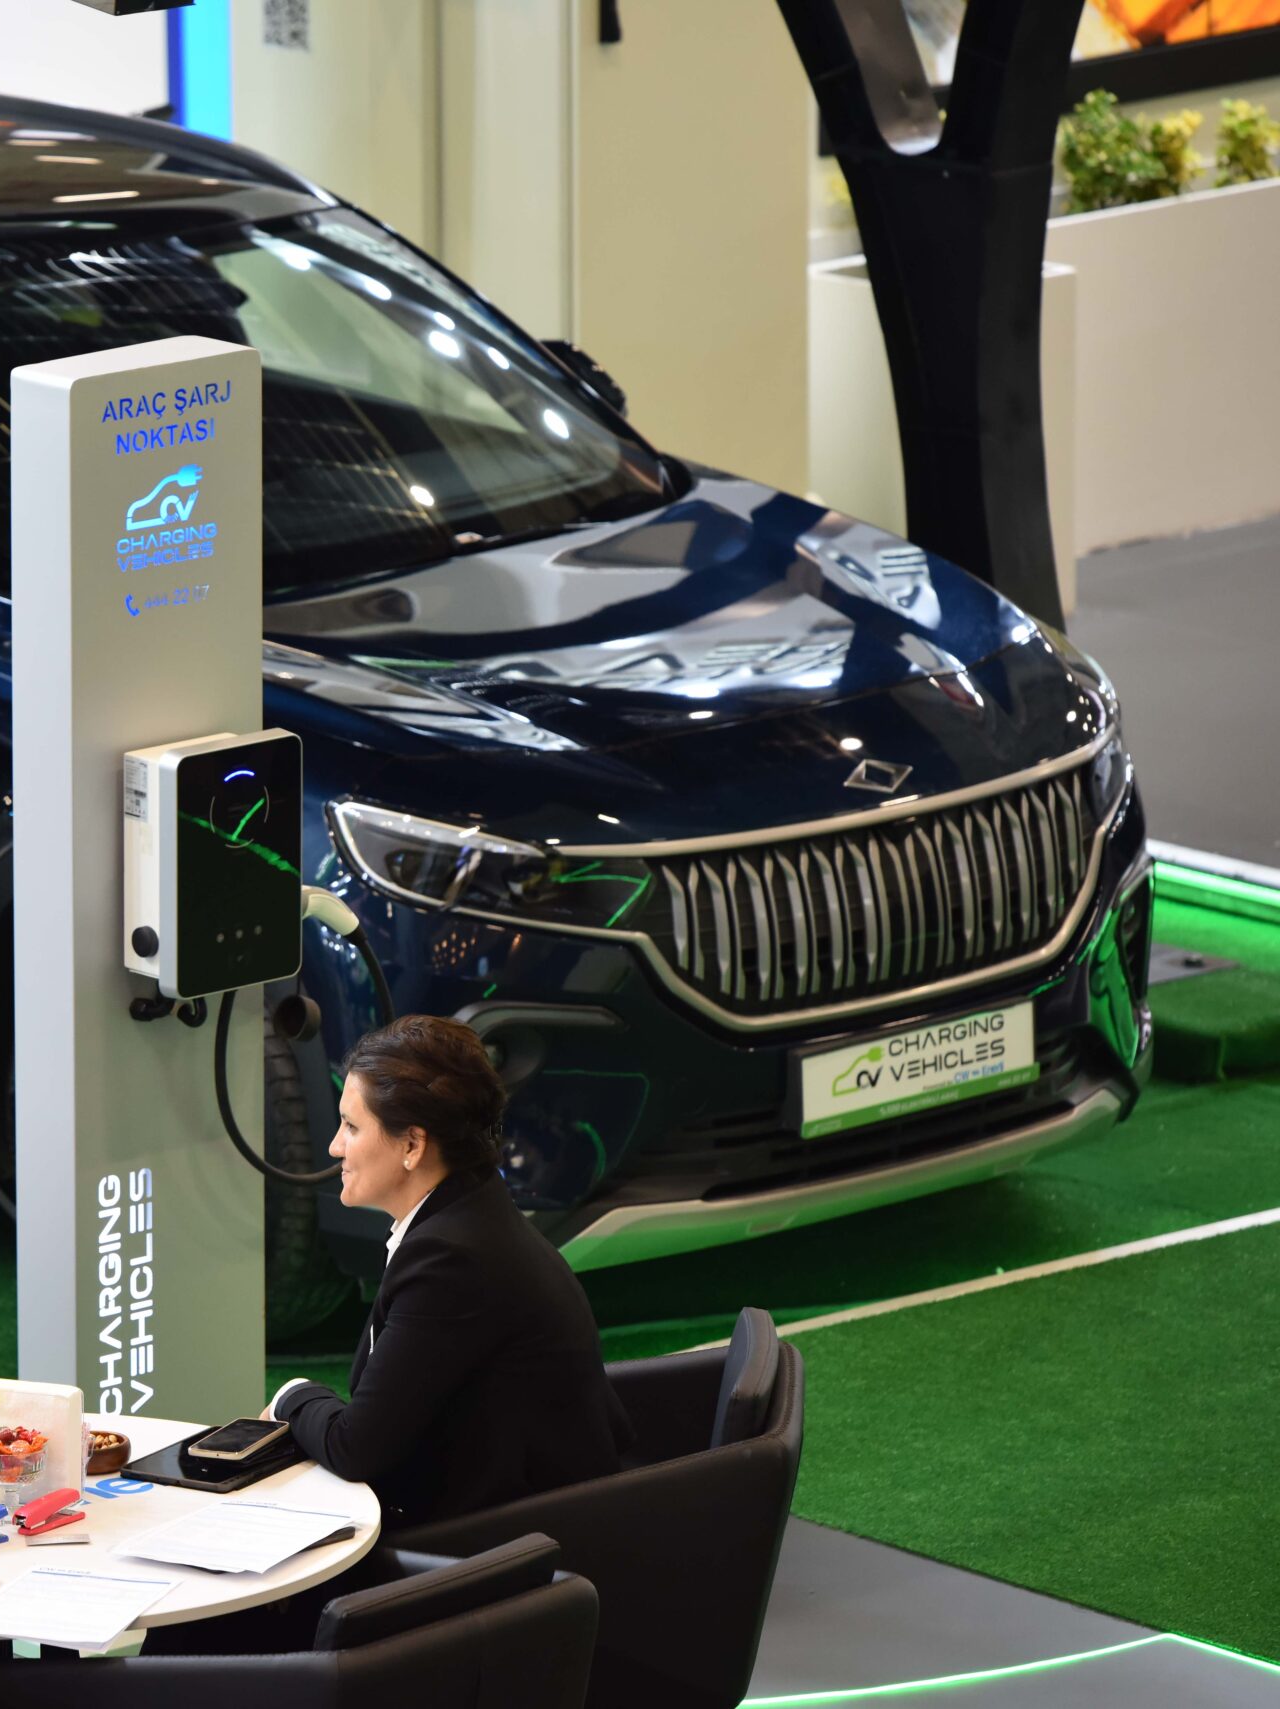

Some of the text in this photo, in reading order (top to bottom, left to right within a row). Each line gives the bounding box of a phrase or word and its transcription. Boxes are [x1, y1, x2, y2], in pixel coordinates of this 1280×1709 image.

[101, 380, 232, 423] ARAÇ ŞARJ
[115, 418, 216, 455] NOKTASI
[116, 523, 218, 555] CHARGING
[116, 541, 215, 573] VEHICLES
[888, 1013, 1005, 1057] CHARGING
[890, 1038, 1005, 1083] VEHICLES
[97, 1174, 123, 1416] CHARGING
[129, 1167, 154, 1414] VEHICLES
